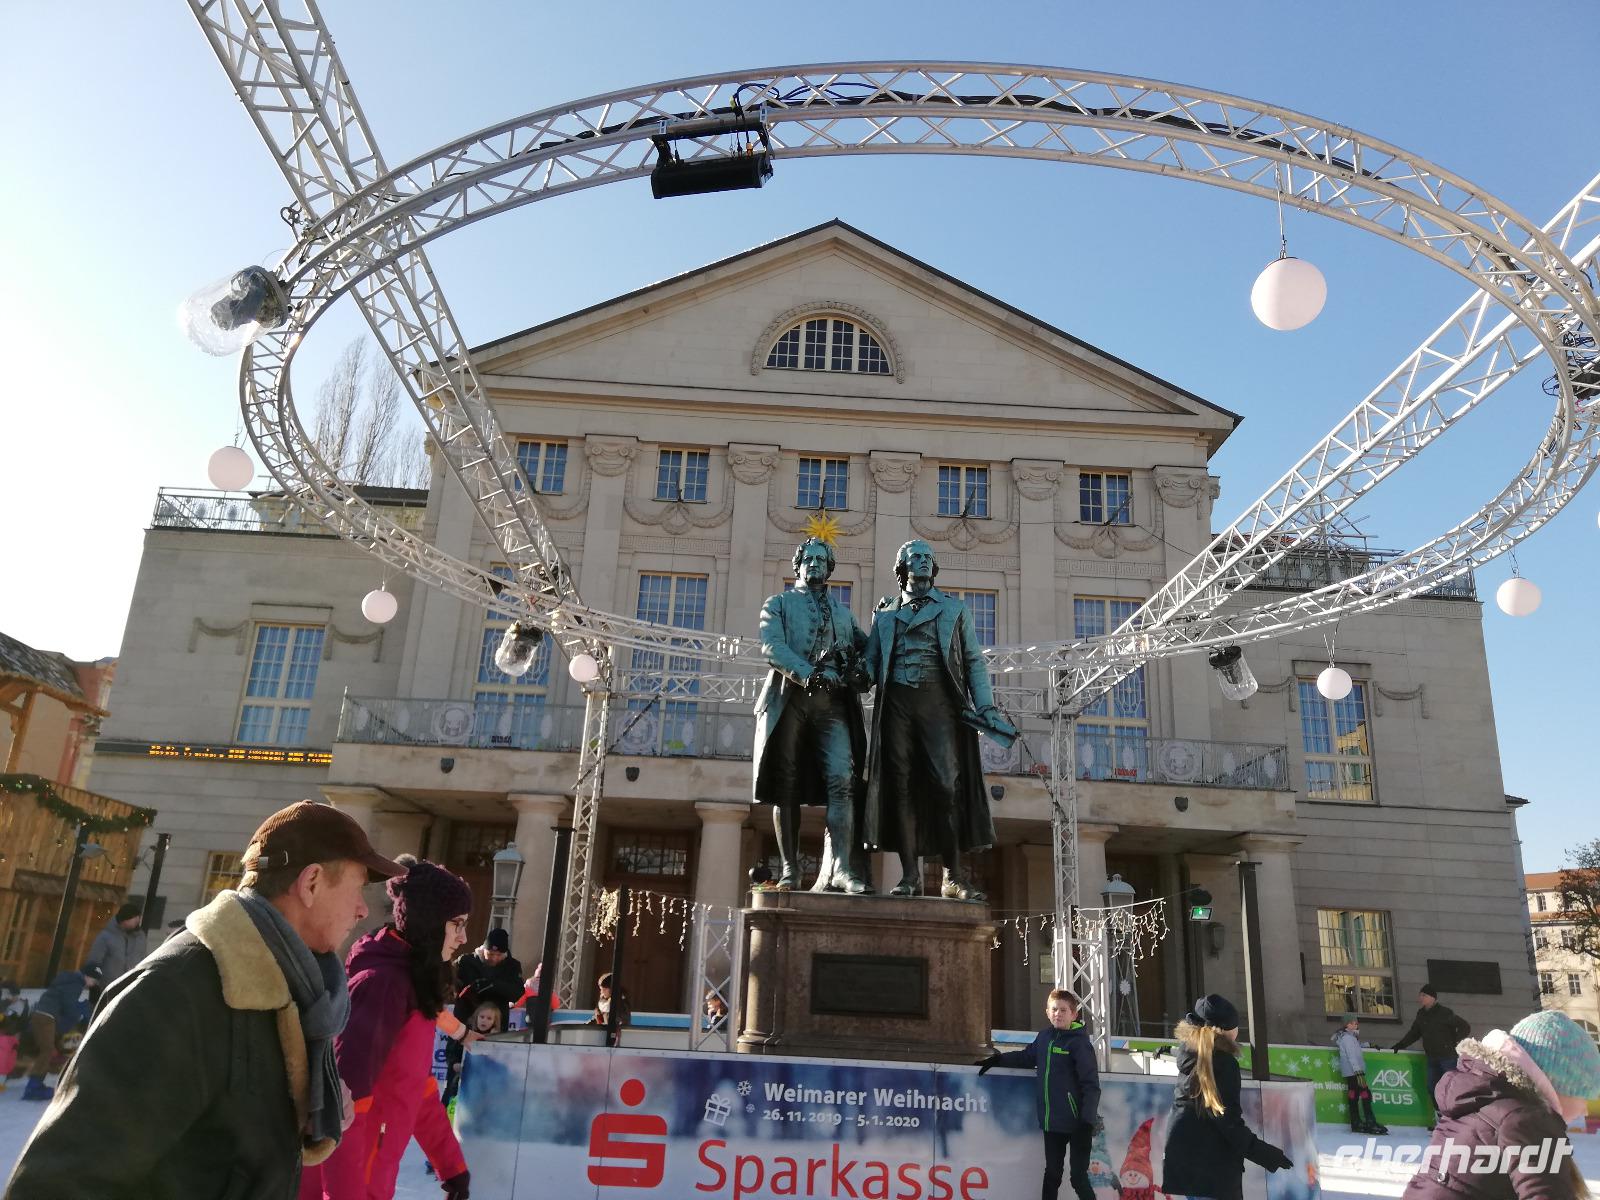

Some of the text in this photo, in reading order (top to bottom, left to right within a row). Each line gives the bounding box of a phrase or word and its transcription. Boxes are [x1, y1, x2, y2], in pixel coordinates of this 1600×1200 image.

[1372, 1069, 1412, 1088] AOK
[764, 1082, 988, 1113] Weimarer Weihnacht
[1372, 1092, 1413, 1105] PLUS
[695, 1139, 989, 1200] Sparkasse
